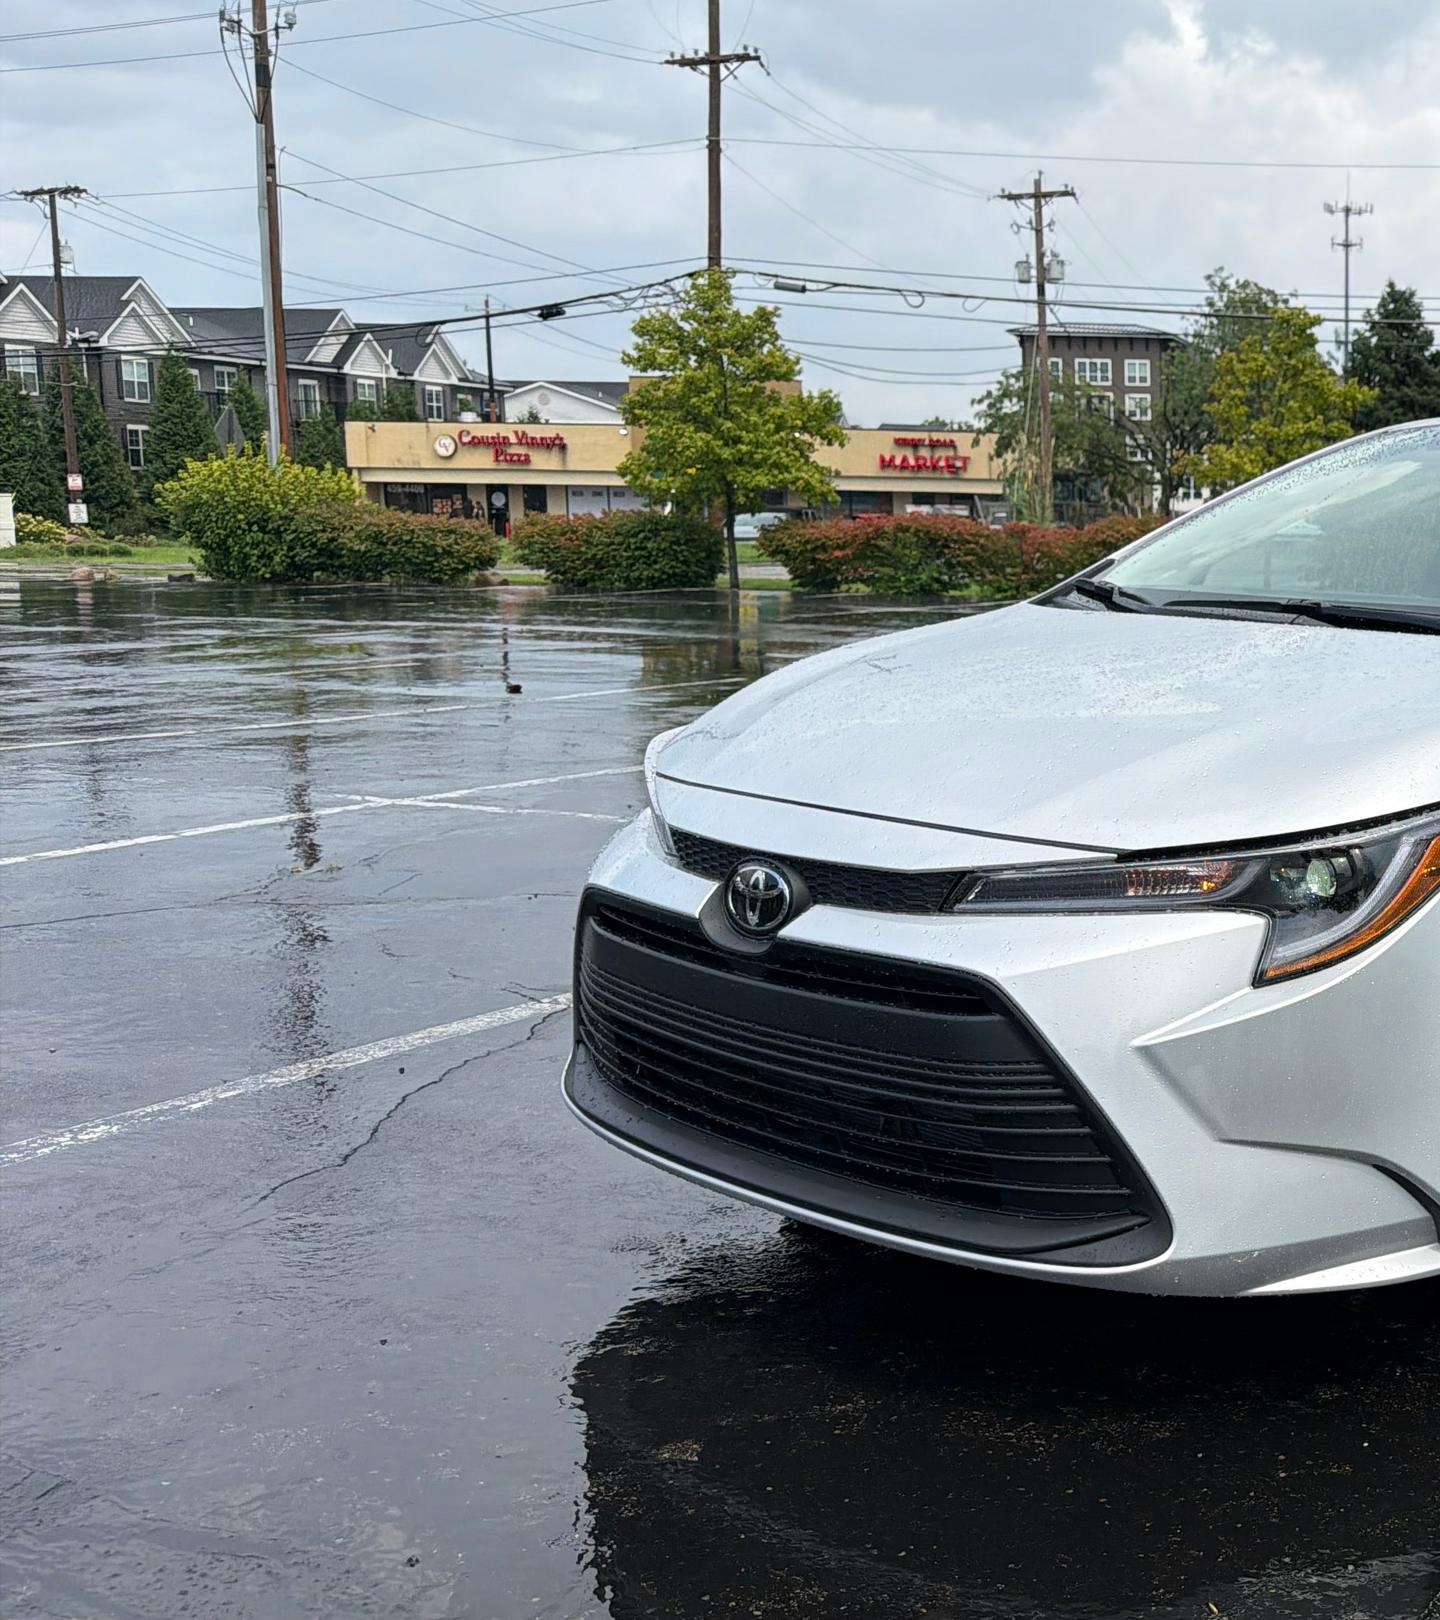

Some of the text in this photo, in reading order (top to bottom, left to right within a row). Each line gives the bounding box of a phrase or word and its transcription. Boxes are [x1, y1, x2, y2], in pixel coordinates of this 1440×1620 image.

[458, 429, 565, 449] Cousin Vinny's
[493, 447, 531, 465] Pizza
[879, 453, 970, 474] MARKET
